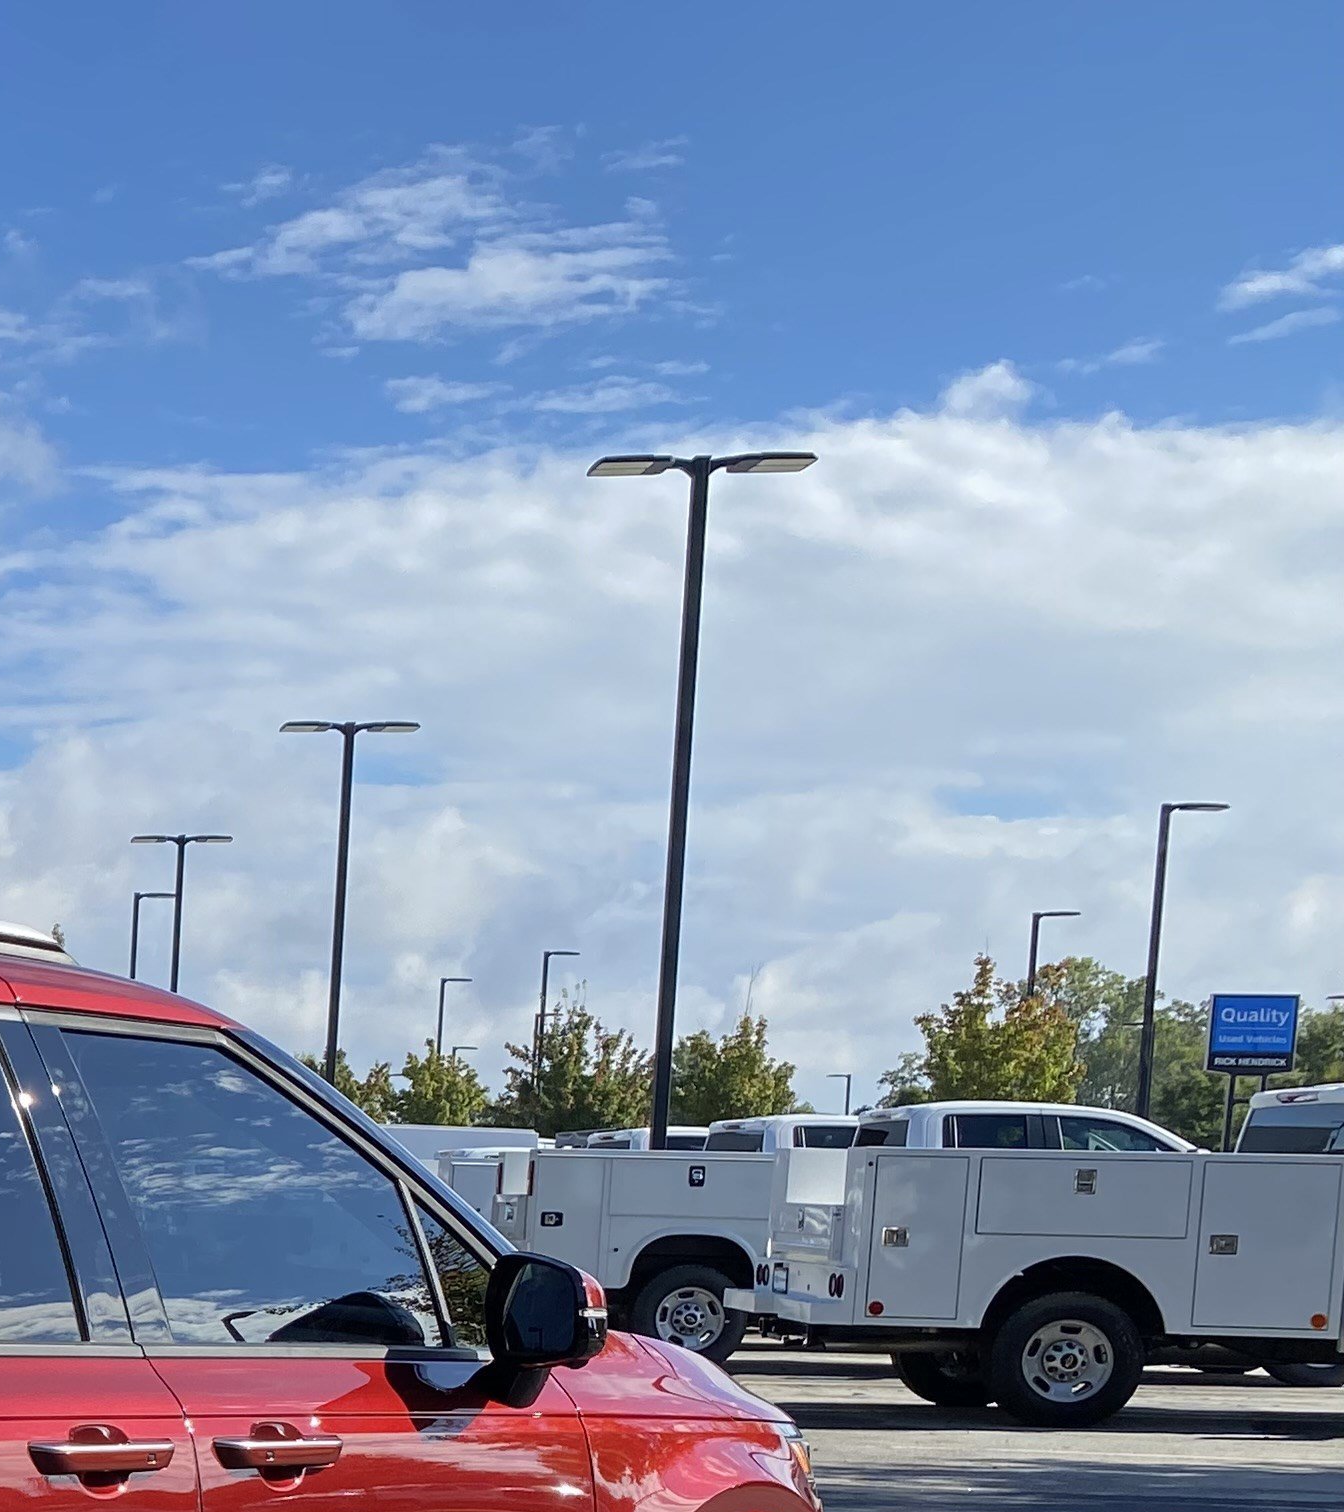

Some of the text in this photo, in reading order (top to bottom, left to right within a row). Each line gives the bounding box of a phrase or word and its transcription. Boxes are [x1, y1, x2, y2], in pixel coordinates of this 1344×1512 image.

[1221, 1007, 1290, 1026] Quality
[1218, 1034, 1244, 1043] Used
[1214, 1057, 1287, 1067] RICK HENDRICK
